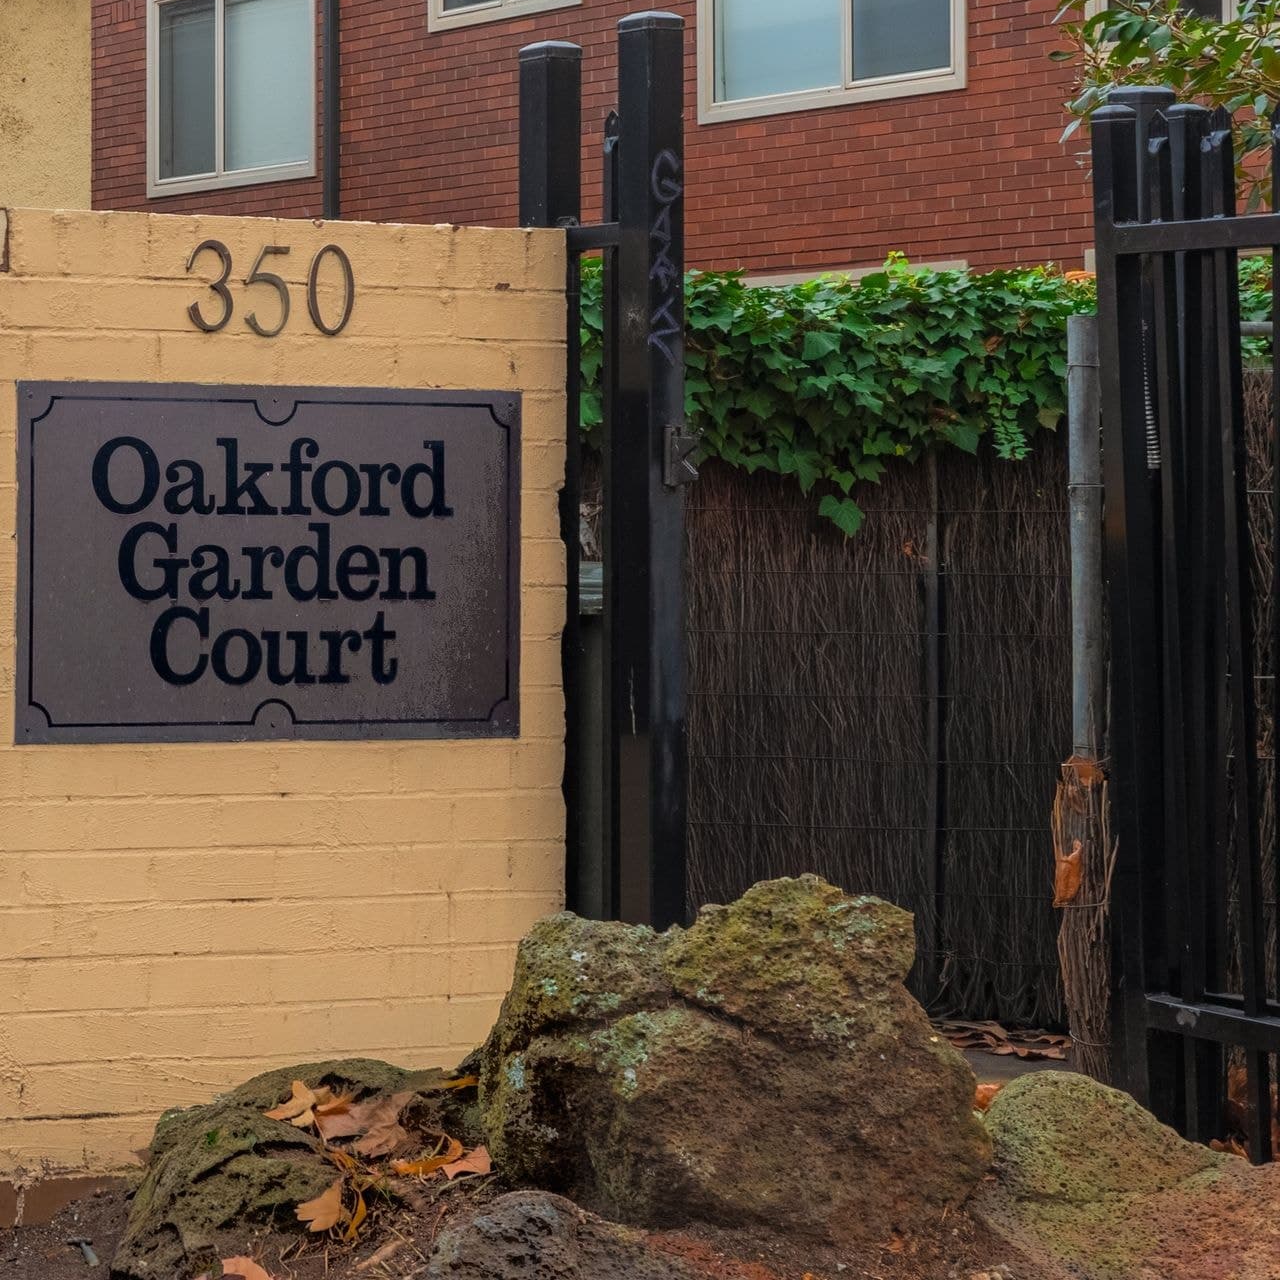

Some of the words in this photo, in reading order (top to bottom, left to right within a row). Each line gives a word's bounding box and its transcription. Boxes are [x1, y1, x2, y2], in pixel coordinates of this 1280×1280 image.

[186, 239, 355, 338] 350
[91, 435, 454, 518] Oakford
[117, 521, 436, 602] Garden
[149, 606, 398, 686] Court
